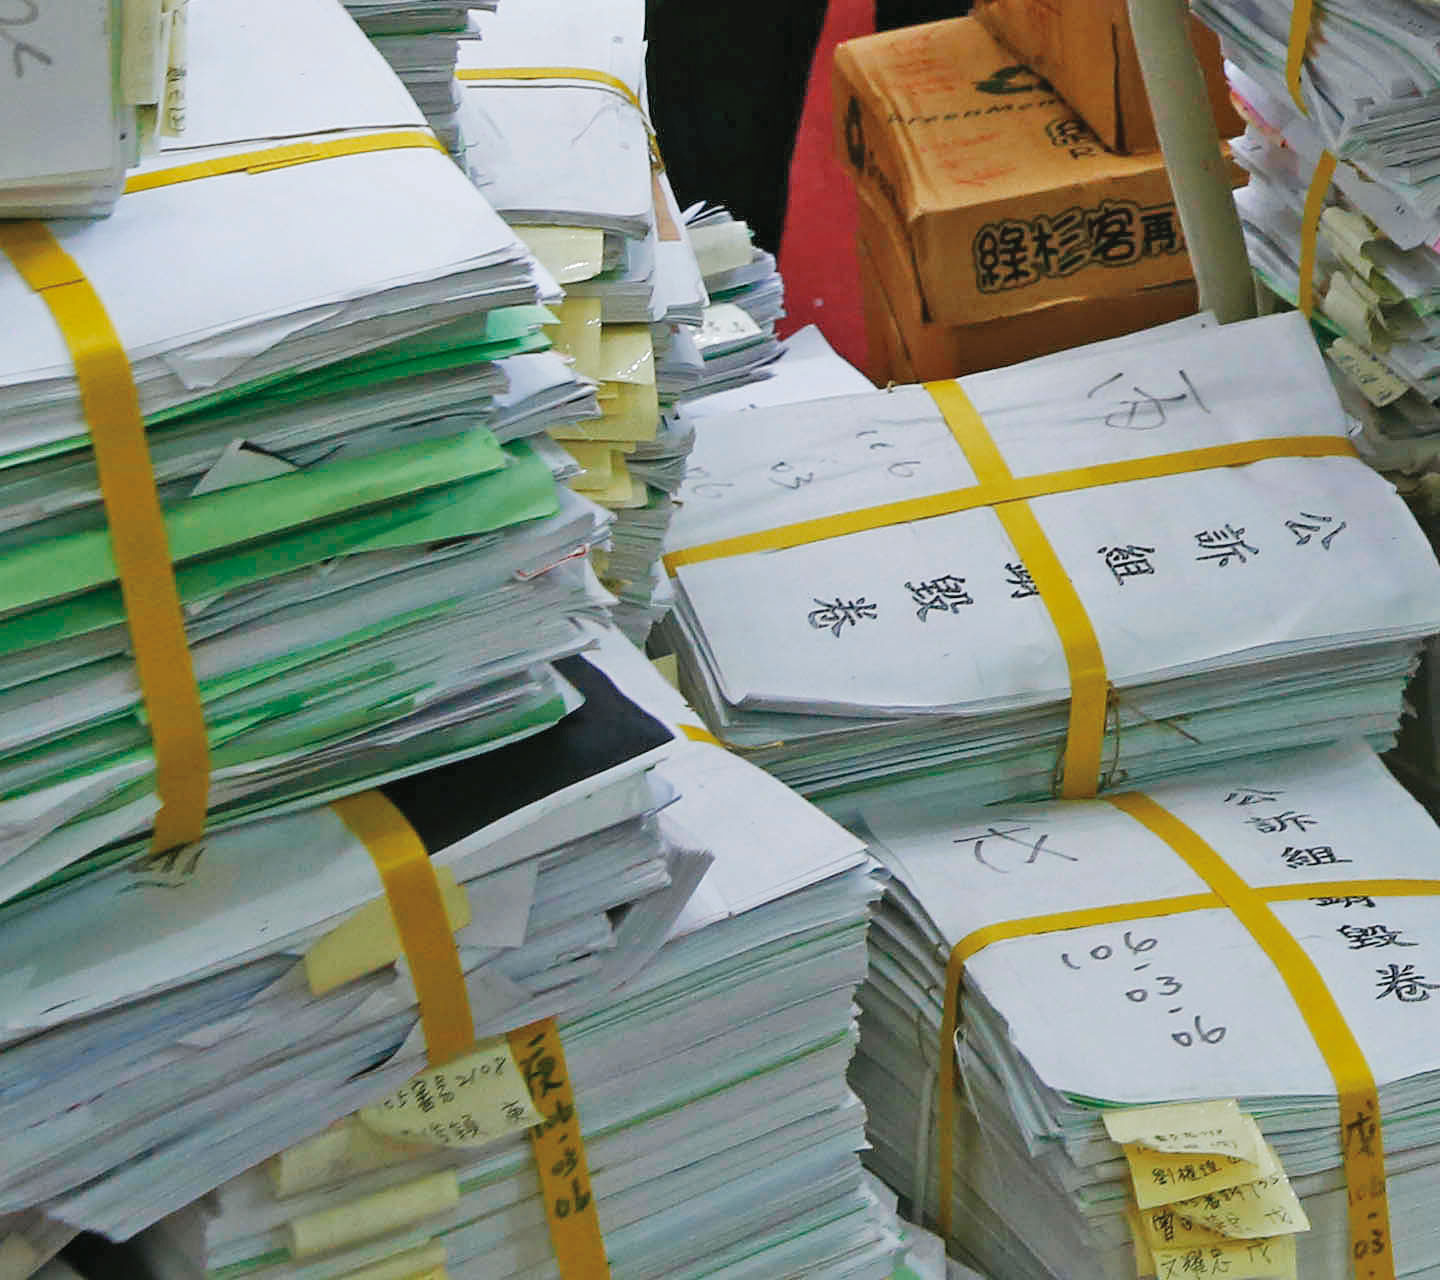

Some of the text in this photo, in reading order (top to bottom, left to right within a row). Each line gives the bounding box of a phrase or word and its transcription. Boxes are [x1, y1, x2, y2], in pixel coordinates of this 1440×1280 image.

[1061, 930, 1159, 970] 106
[1125, 975, 1183, 1004] 03
[1170, 1015, 1228, 1049] 06
